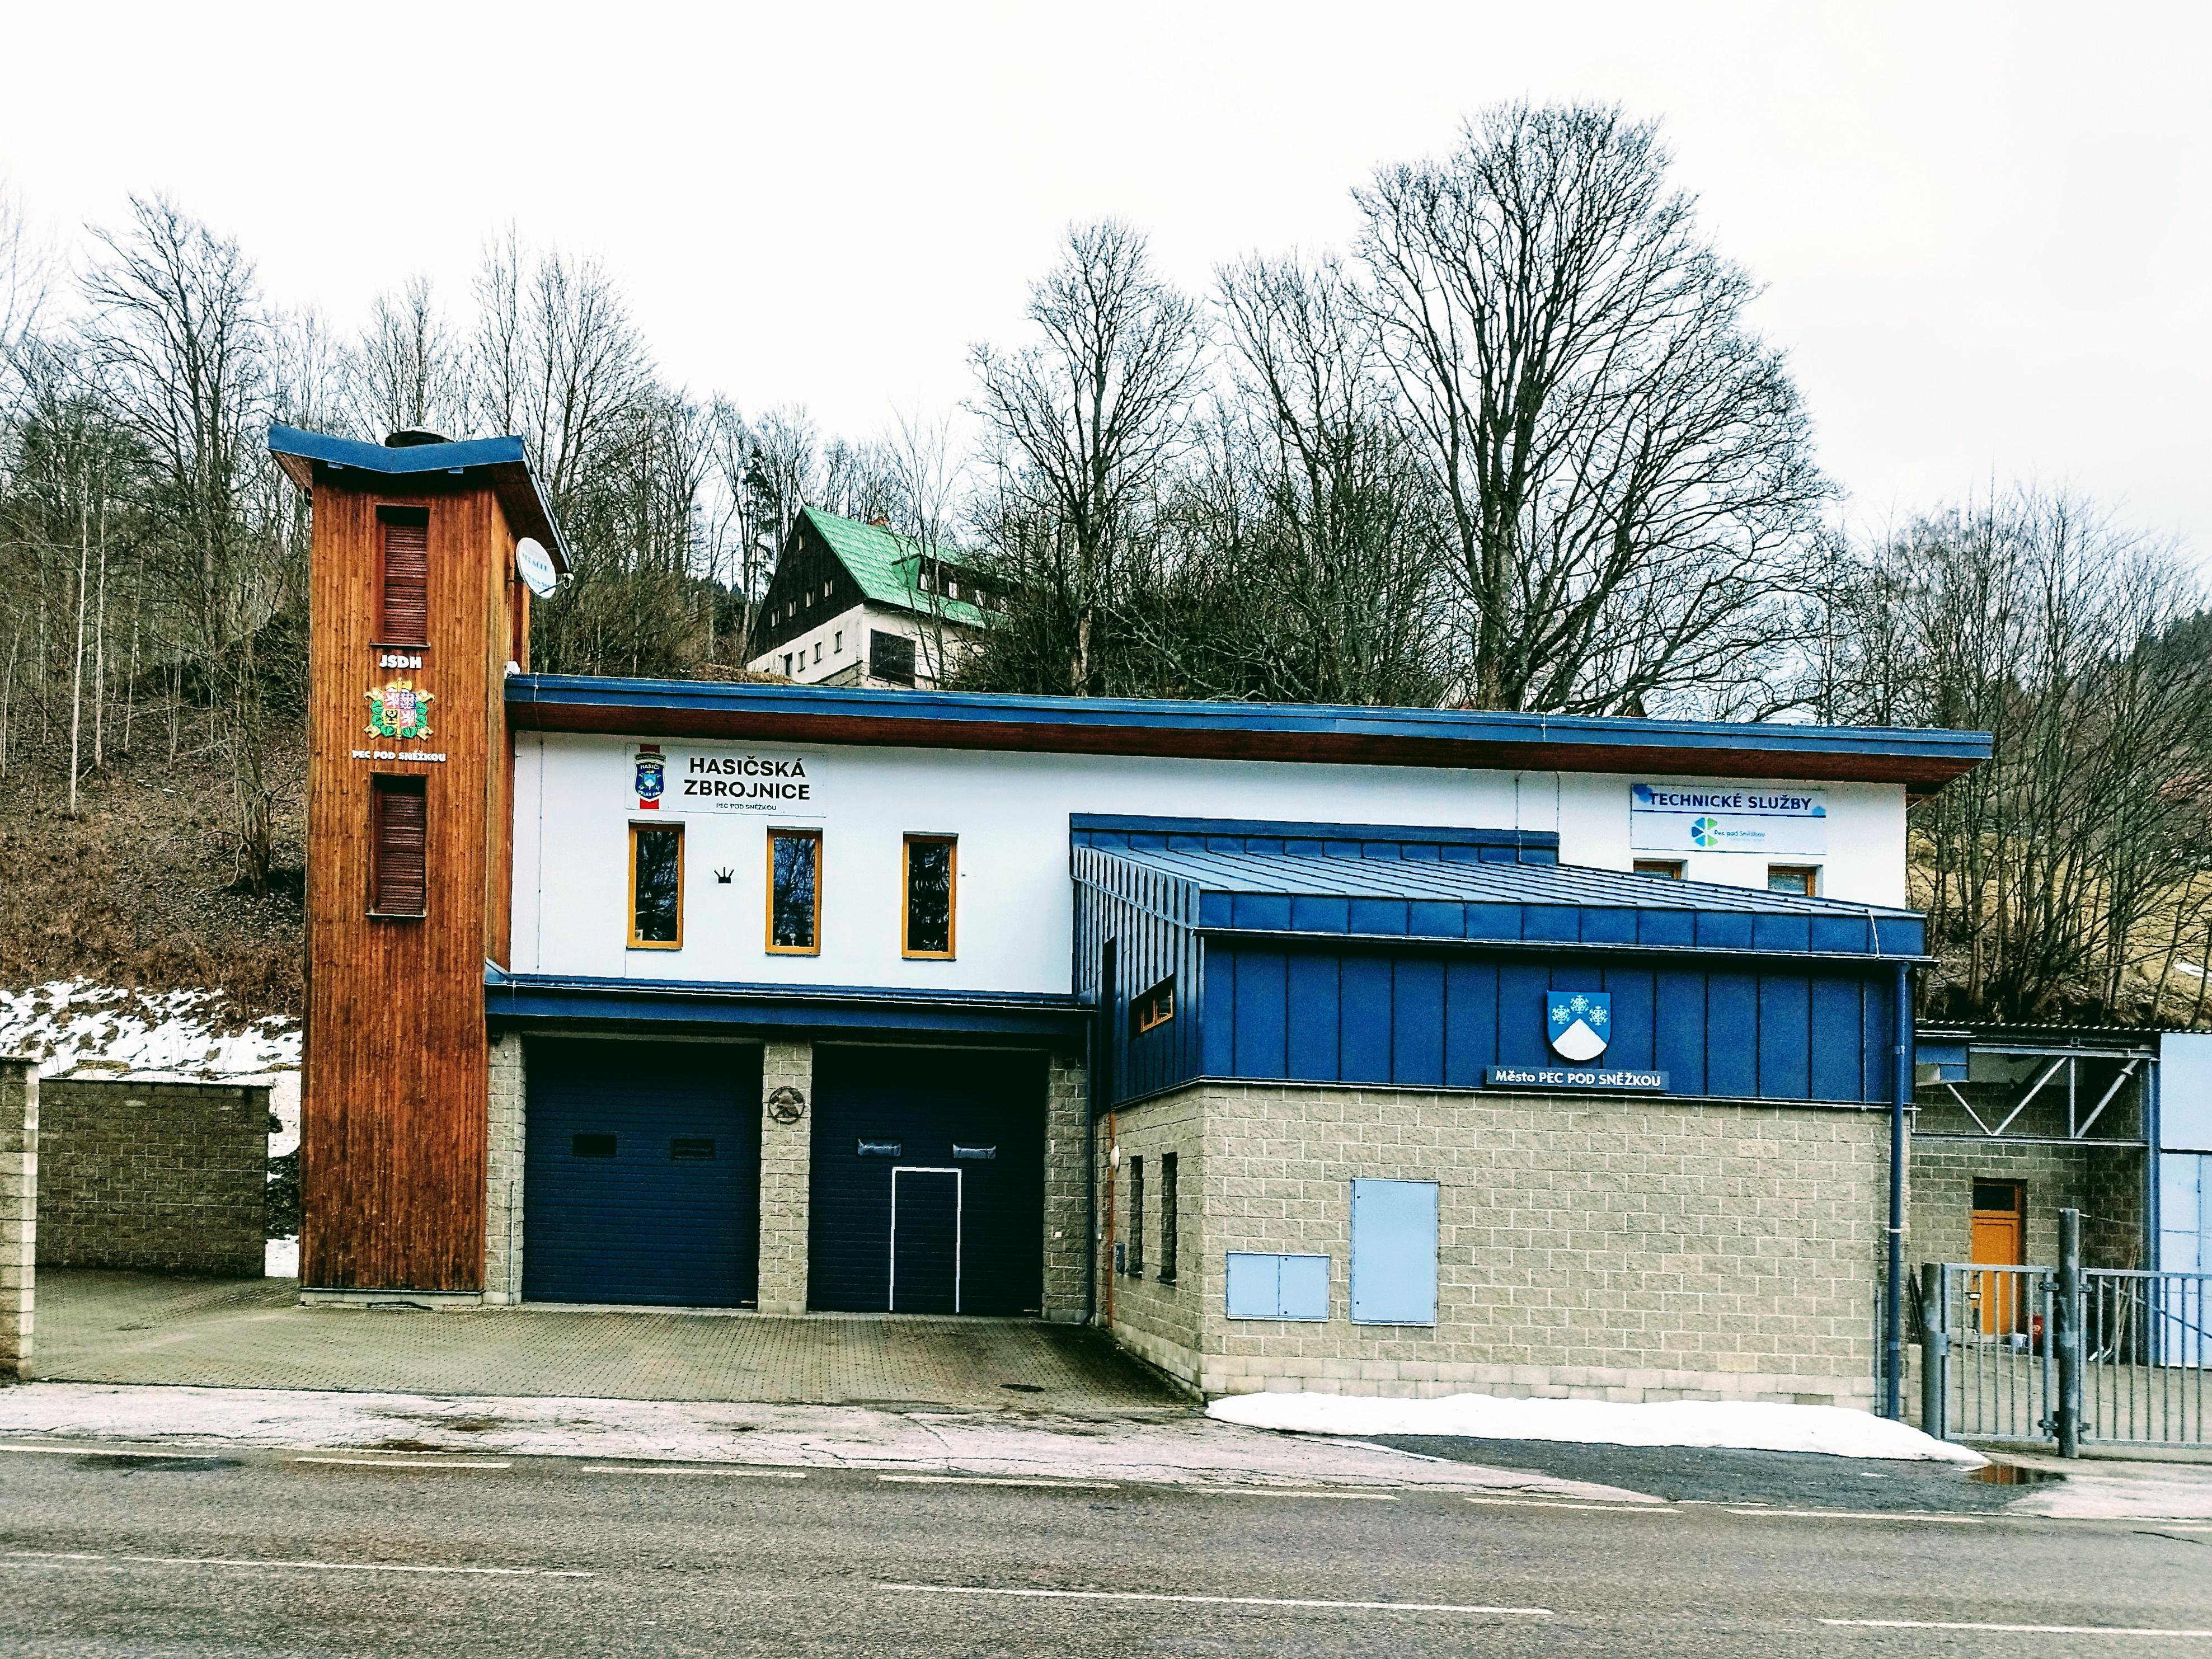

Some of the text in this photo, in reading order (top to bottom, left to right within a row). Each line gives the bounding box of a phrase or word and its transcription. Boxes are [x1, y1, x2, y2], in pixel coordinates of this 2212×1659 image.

[379, 655, 422, 668] JSDH
[352, 750, 446, 762] PEC POD SNĚŽKOU
[689, 756, 806, 778] HASIČSKÁ
[684, 779, 810, 800] ZBROJNICE
[1650, 793, 1812, 810] TECHNICKÉ SLUŽBY
[1495, 1070, 1661, 1087] Město PEC POD SNĚŽKOU
